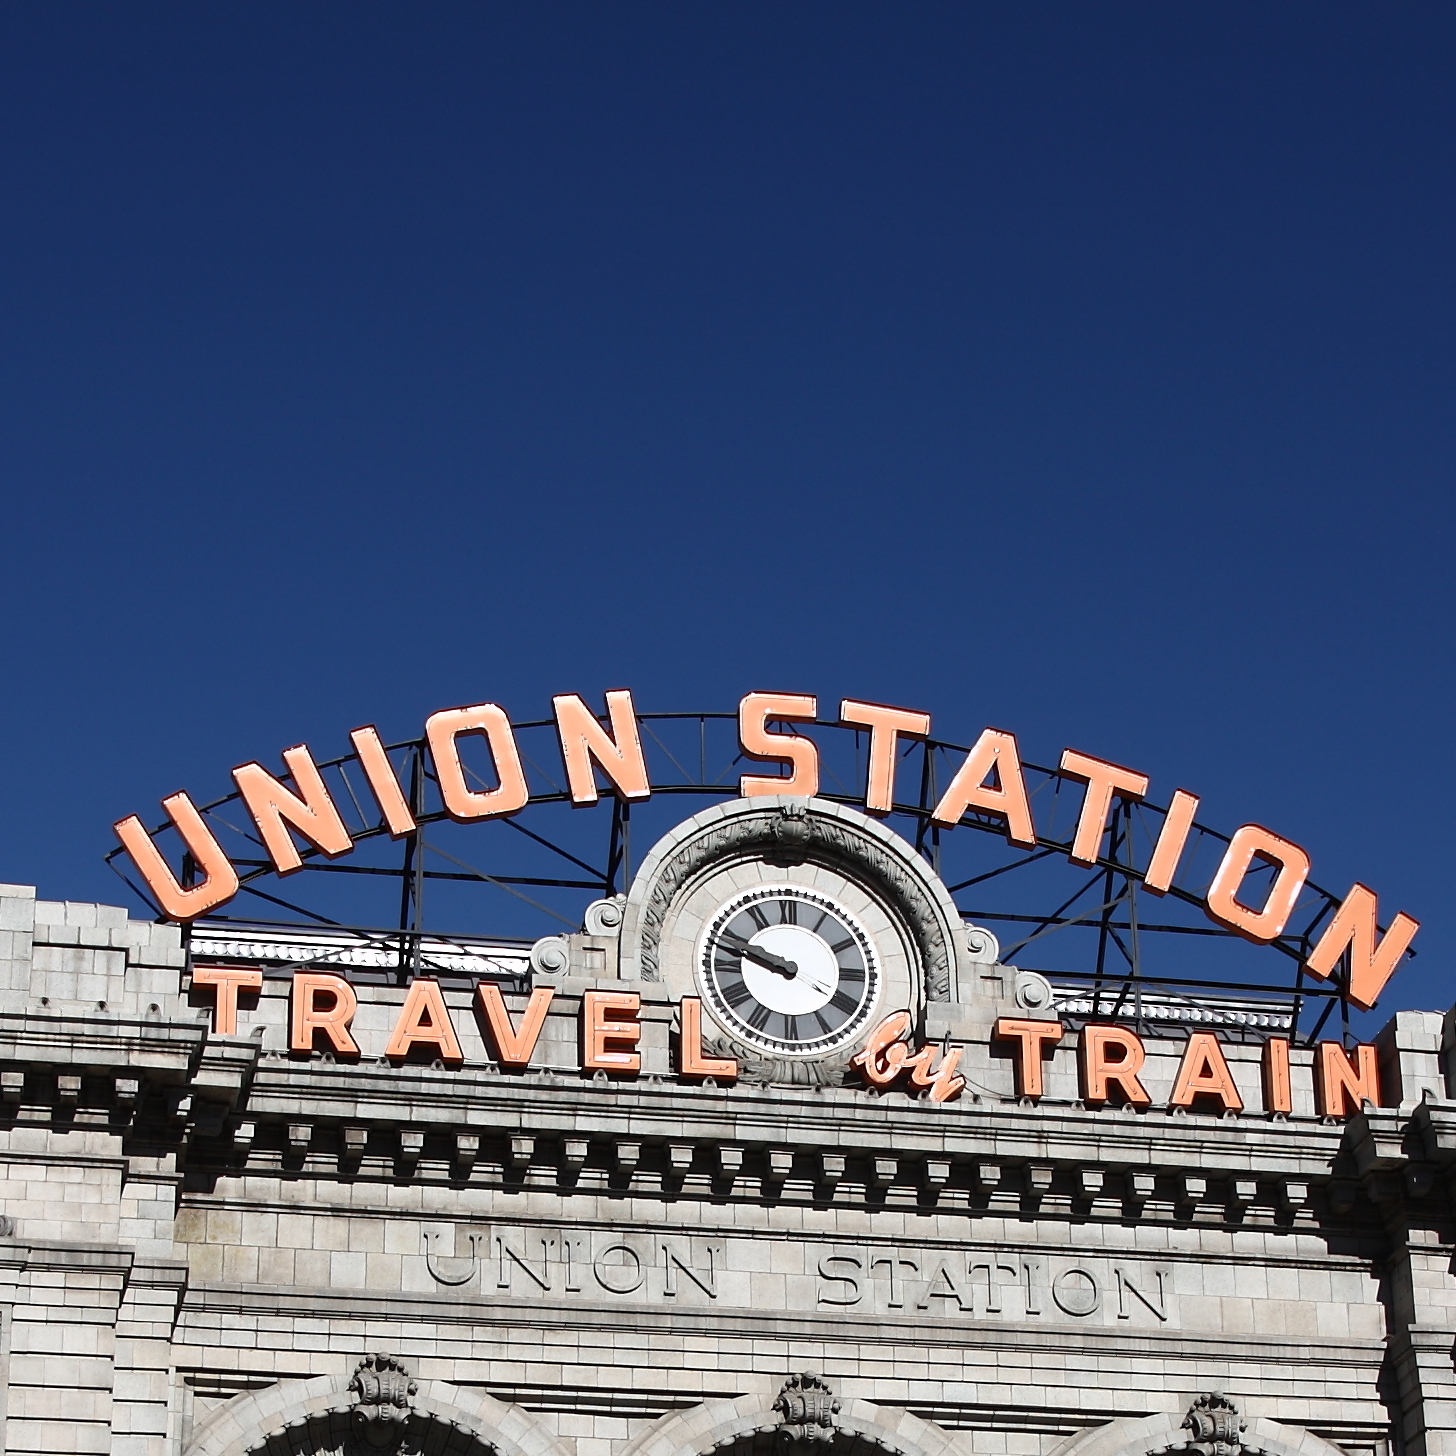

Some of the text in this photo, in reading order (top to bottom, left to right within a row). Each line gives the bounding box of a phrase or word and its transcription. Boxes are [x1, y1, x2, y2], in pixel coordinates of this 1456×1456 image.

[113, 688, 1422, 1012] UNION STATION
[192, 967, 1383, 1118] TRAVEL by TRAIN
[423, 1231, 1169, 1322] UNION STATION
